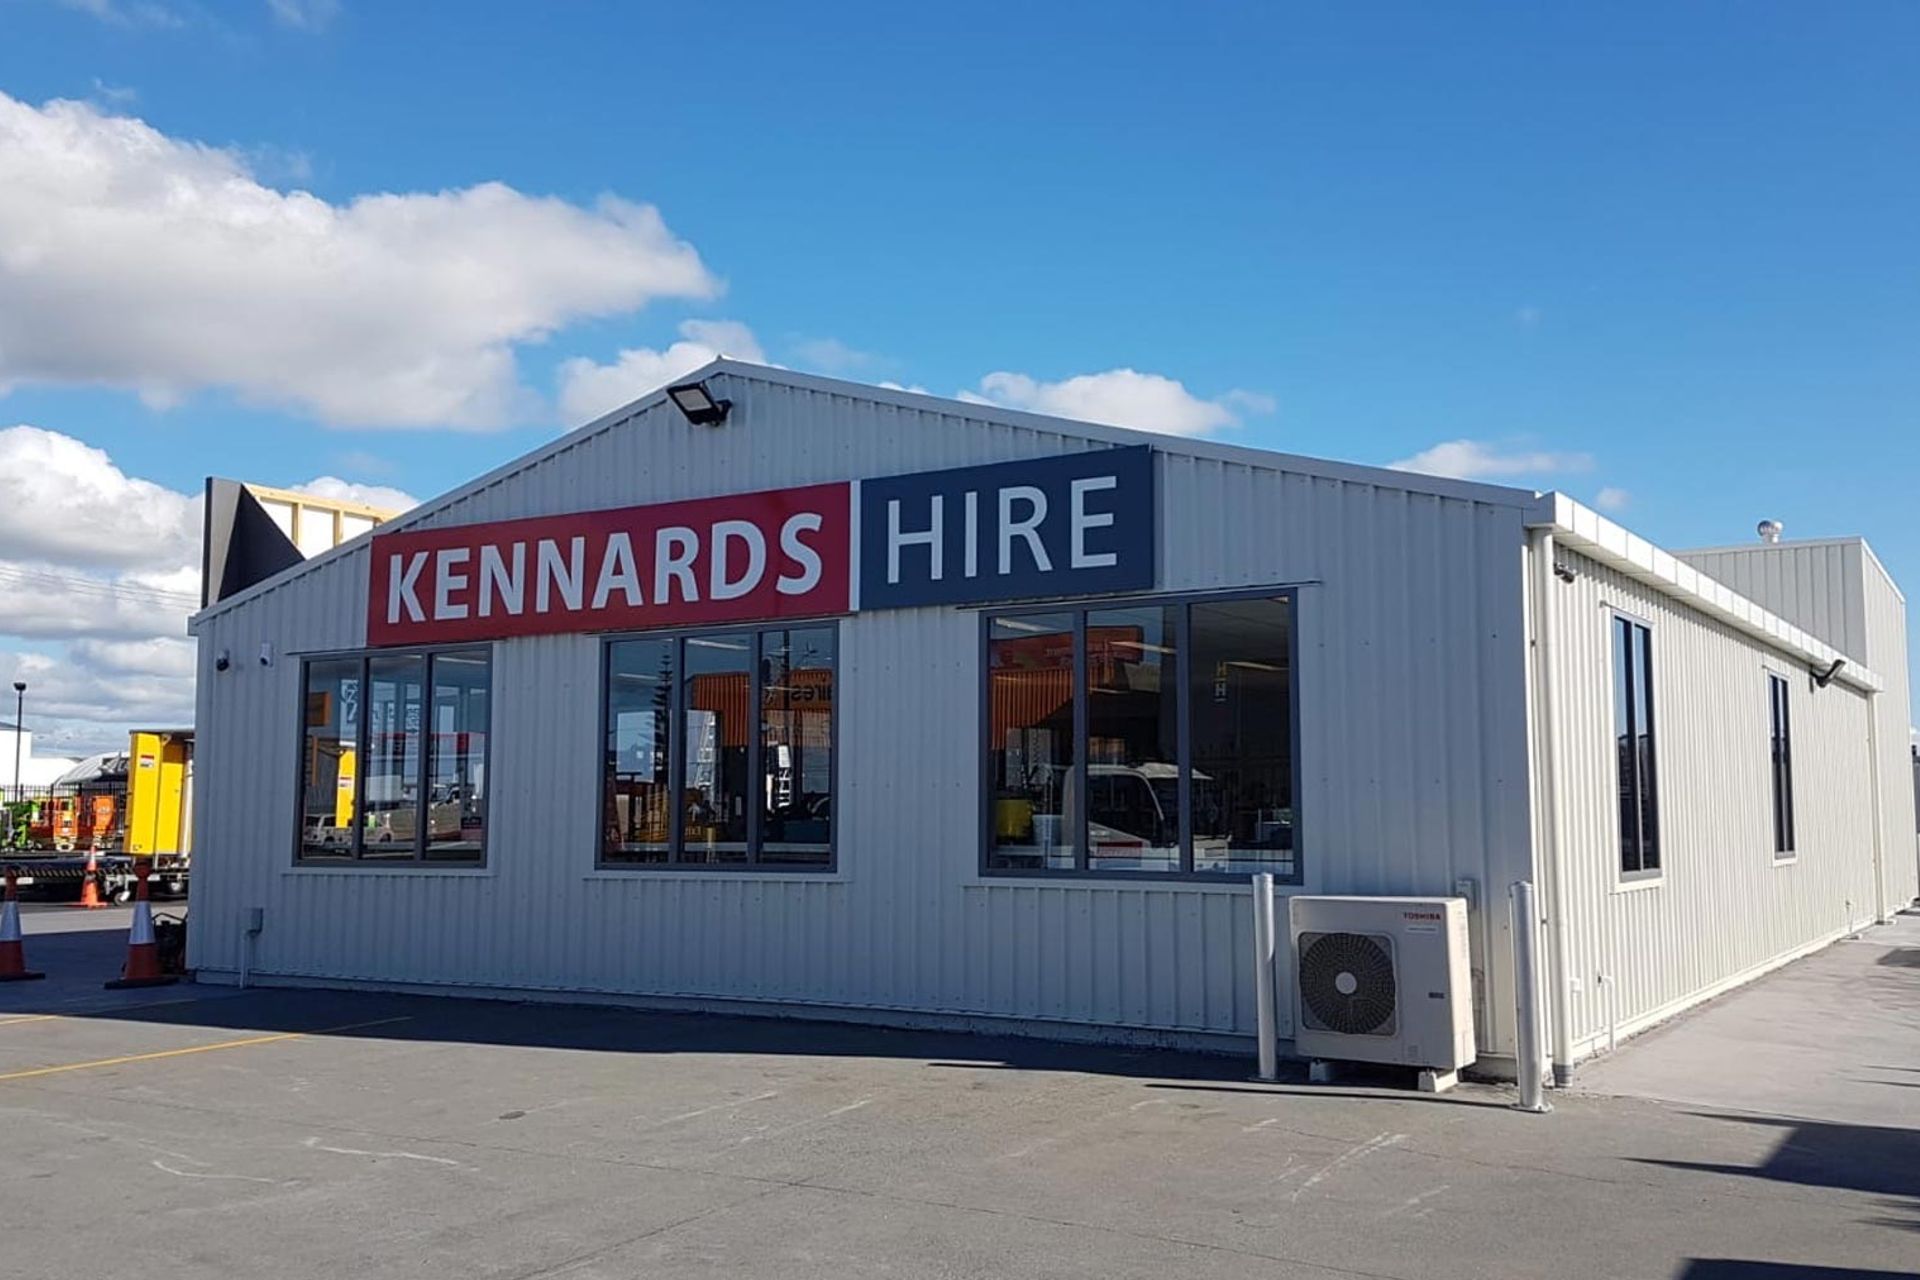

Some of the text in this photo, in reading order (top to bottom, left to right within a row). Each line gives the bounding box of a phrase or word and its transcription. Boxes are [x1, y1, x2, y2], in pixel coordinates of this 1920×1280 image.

[387, 474, 1118, 624] KENNARDS HIRE
[1403, 911, 1441, 921] TOSHIBA
